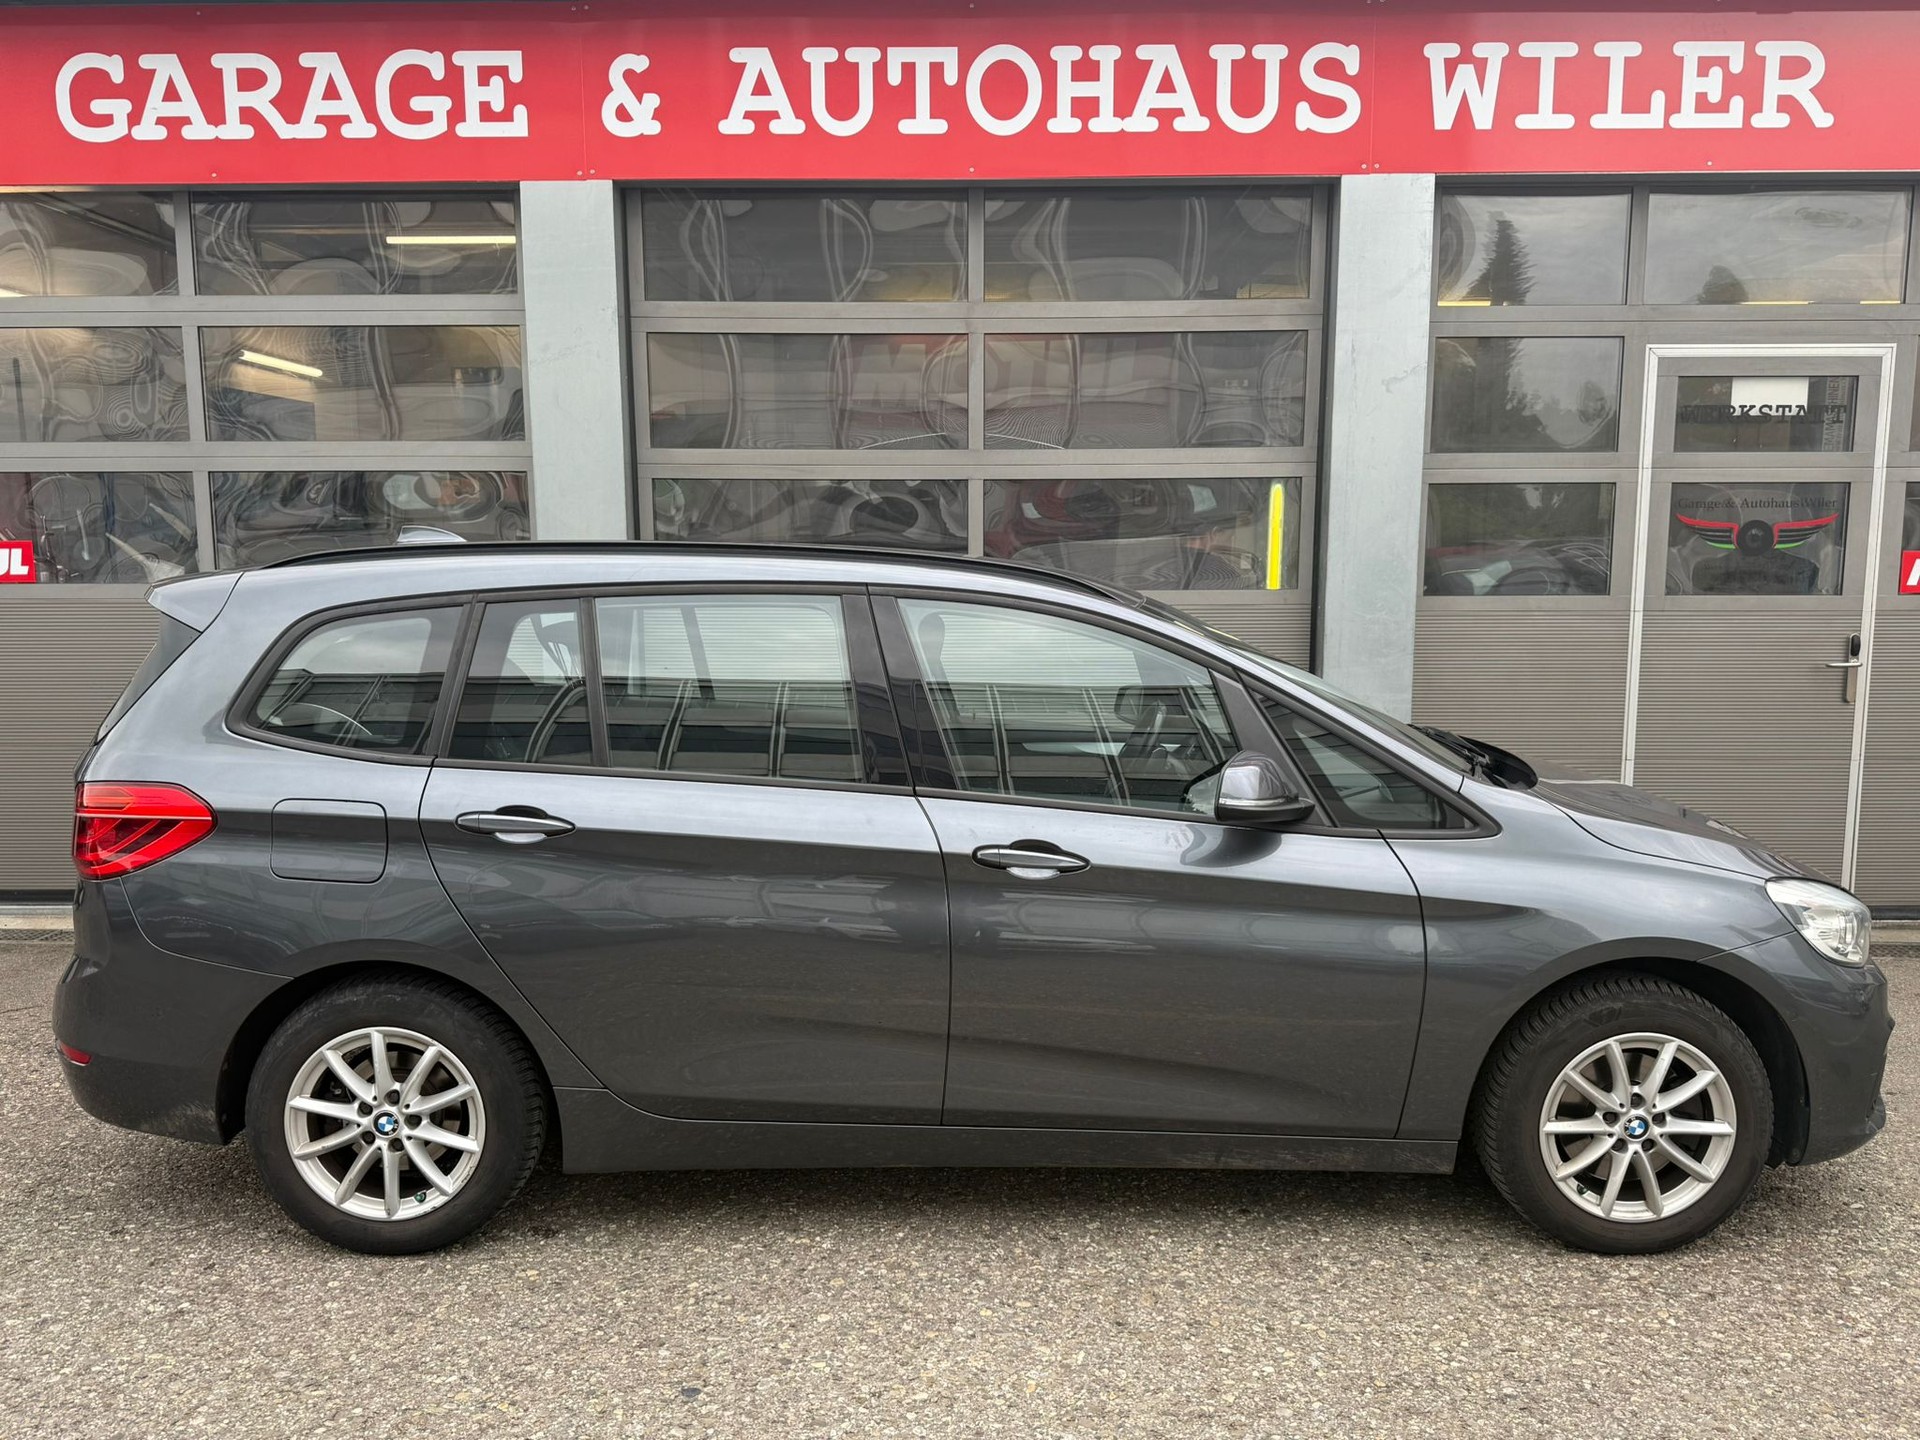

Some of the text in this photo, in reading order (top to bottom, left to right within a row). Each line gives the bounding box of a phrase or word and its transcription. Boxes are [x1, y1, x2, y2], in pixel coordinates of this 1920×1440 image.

[55, 40, 1835, 143] GARAGE & AUTOHAUS WILER
[1680, 404, 1848, 424] WERKSTATT
[1677, 497, 1720, 511] Garage
[1739, 497, 1800, 509] Autohaus
[1801, 496, 1838, 508] Wiler
